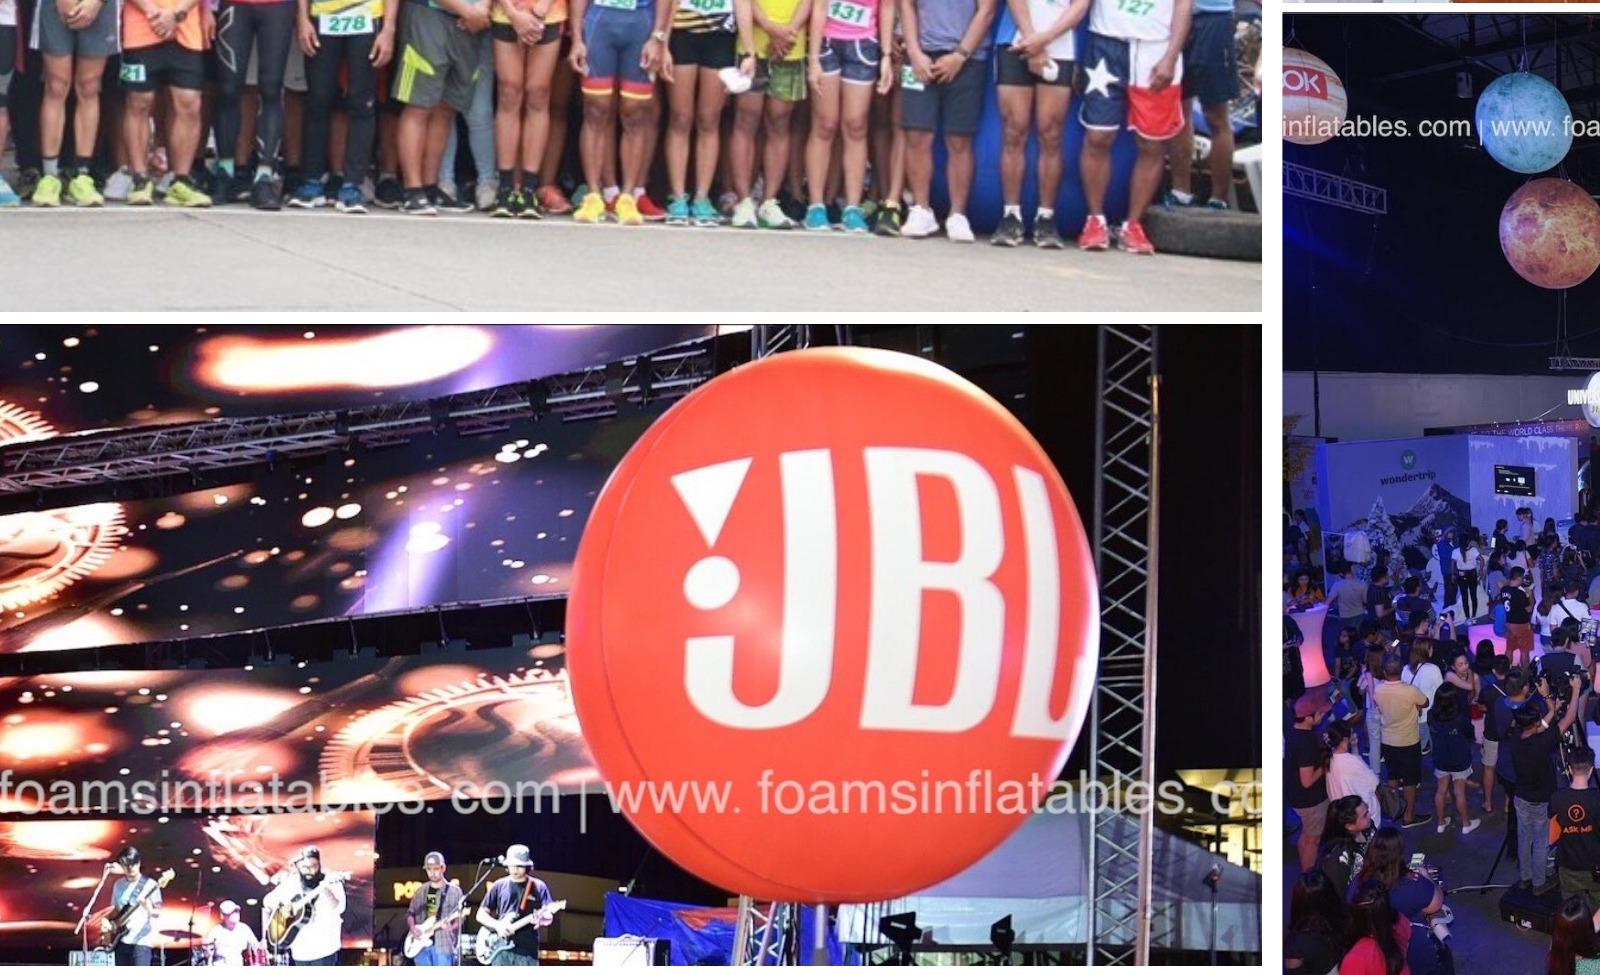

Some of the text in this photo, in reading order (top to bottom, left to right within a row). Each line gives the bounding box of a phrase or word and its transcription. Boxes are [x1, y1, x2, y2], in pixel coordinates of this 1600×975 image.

[328, 15, 367, 32] 278
[1508, 427, 1533, 437] WORLD
[1380, 469, 1437, 486] wondertrip
[671, 449, 1088, 740] JBL
[1563, 825, 1593, 834] ASK ME
